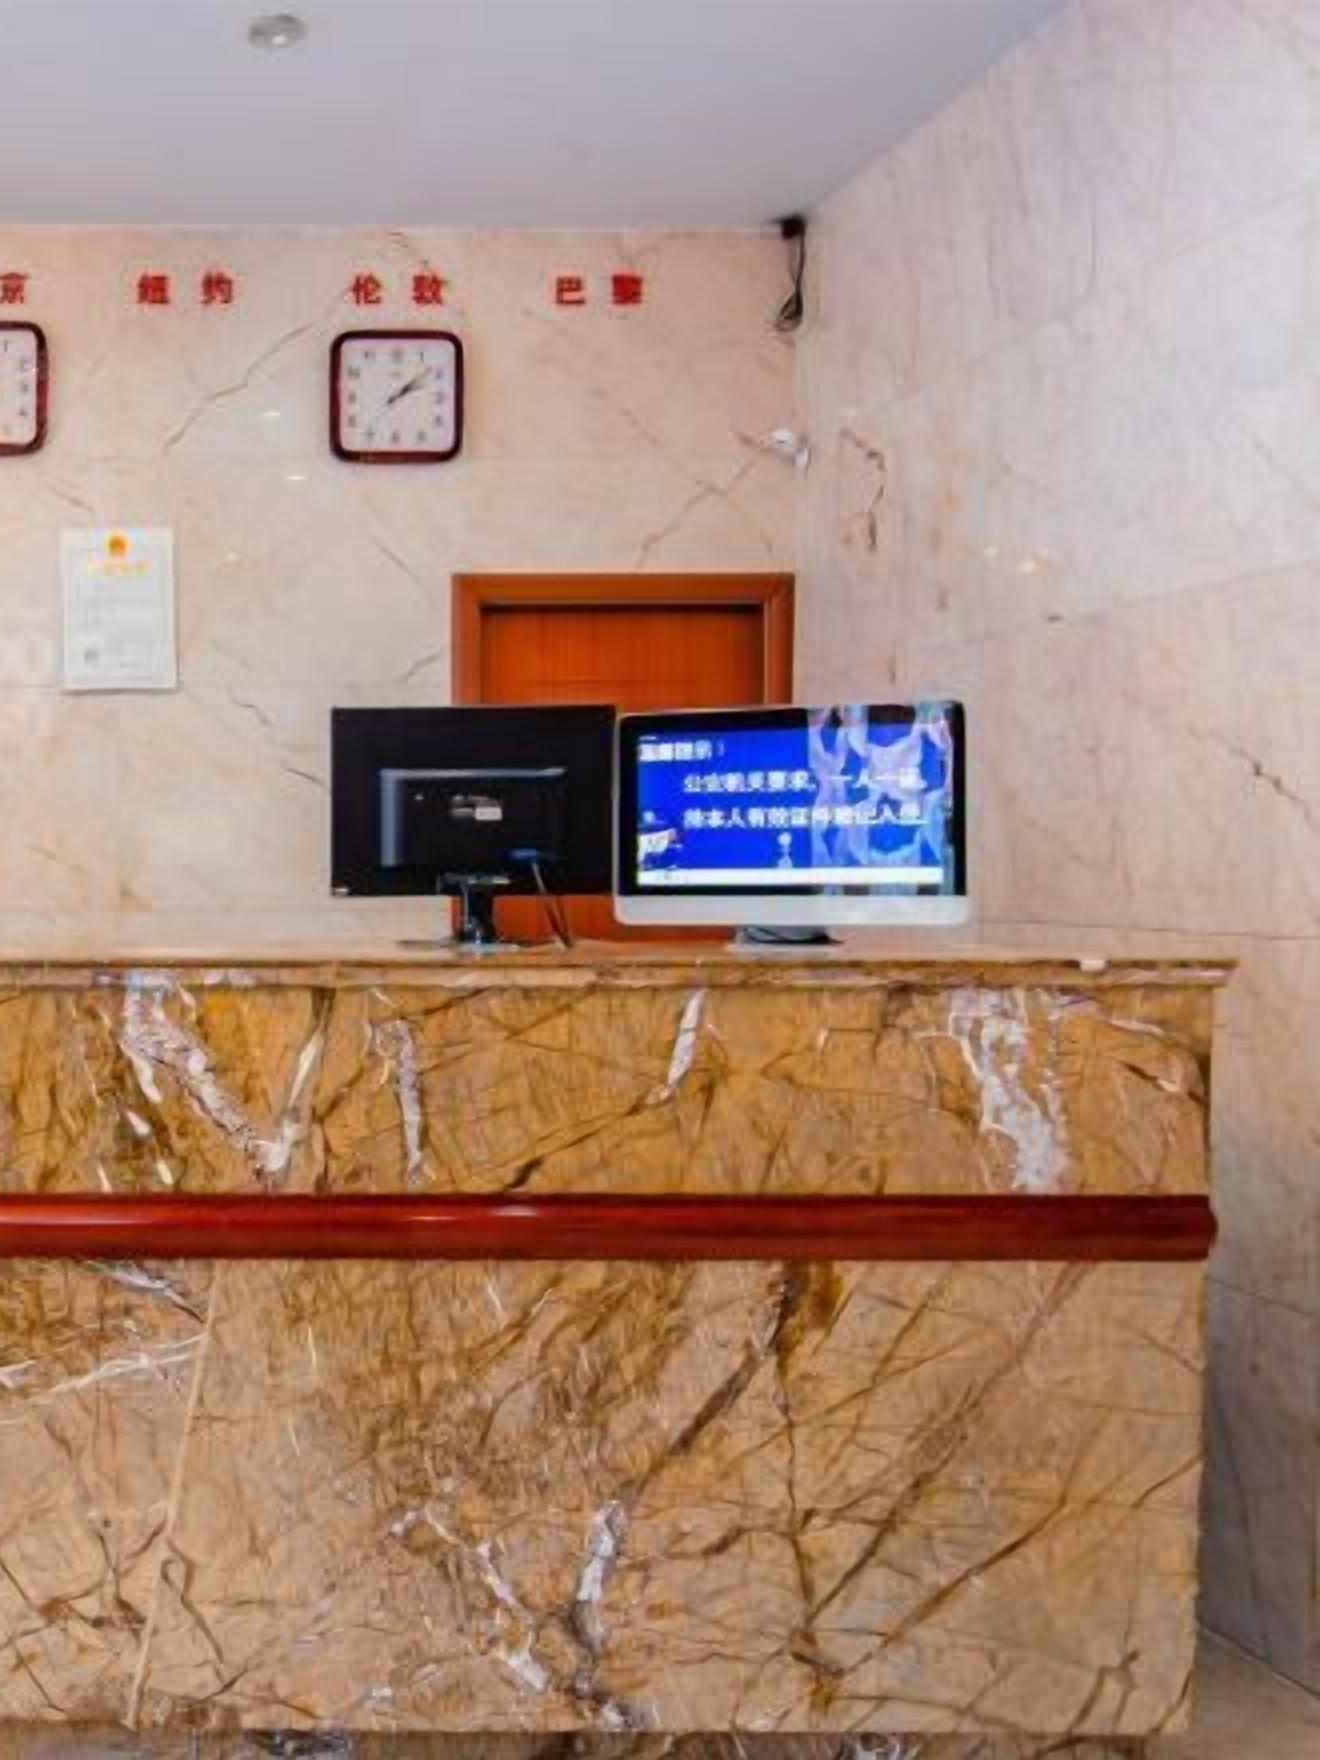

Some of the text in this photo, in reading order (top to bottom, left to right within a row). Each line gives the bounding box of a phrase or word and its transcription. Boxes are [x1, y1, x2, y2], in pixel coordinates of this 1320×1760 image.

[137, 273, 233, 305] 纽约
[350, 272, 448, 305] 伦敦
[556, 274, 642, 305] 巴黎
